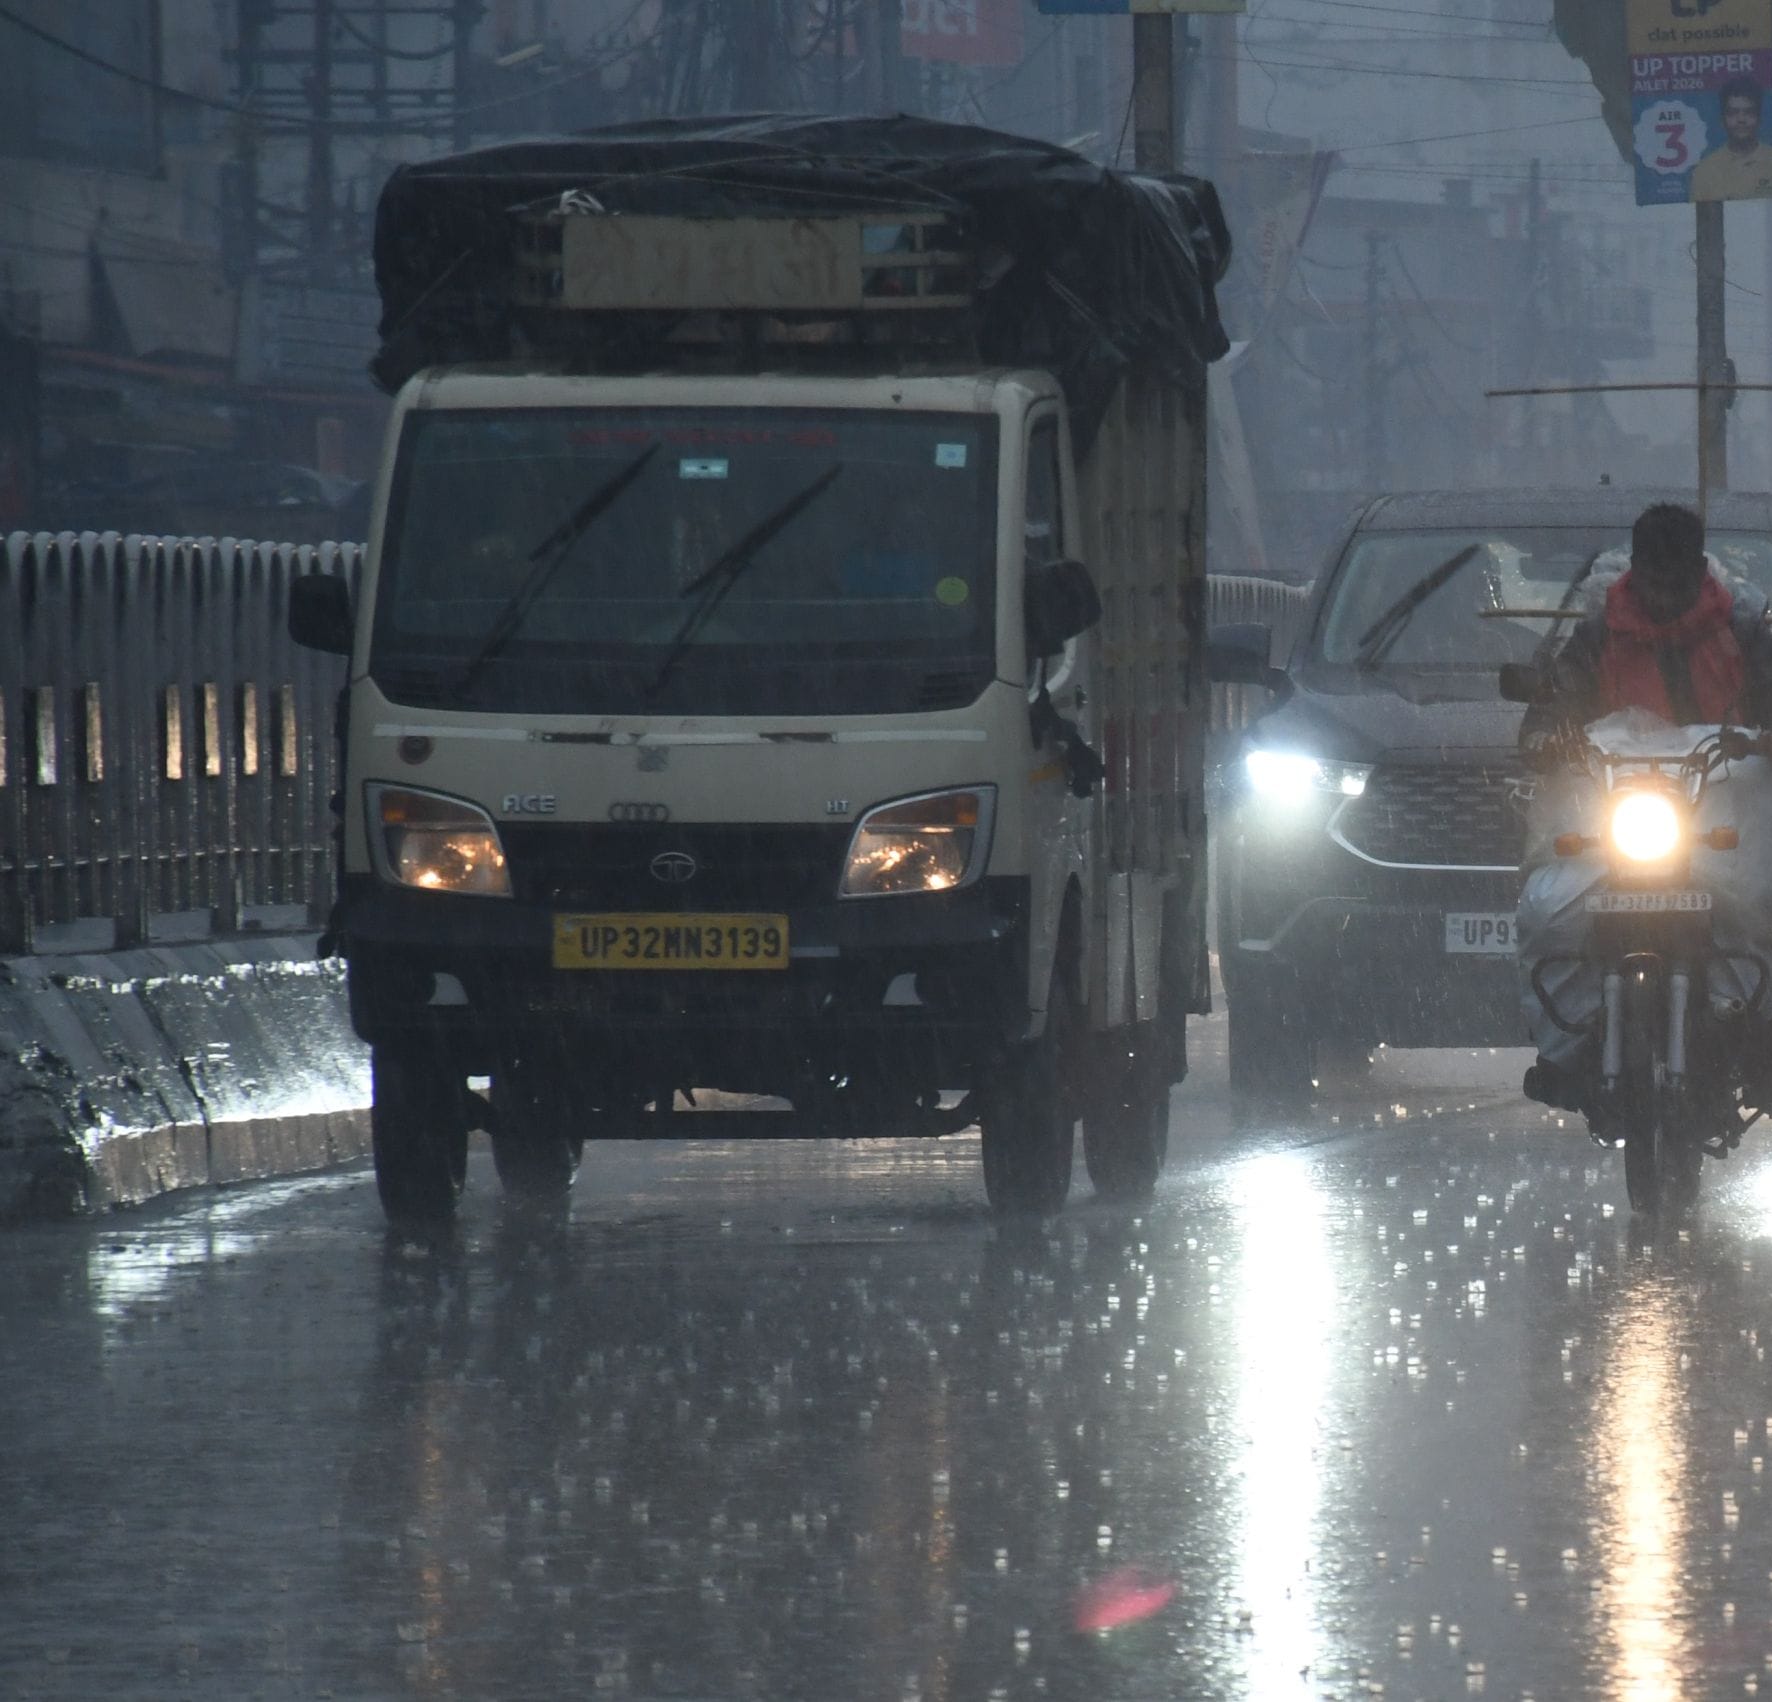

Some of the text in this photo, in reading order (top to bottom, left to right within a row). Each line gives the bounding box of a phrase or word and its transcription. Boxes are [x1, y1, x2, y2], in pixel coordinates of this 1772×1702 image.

[1683, 25, 1750, 43] possible
[1634, 54, 1754, 76] UP TOPPER
[1633, 79, 1705, 92] AILET 2026
[1658, 111, 1682, 121] AIR
[1654, 123, 1688, 168] 3
[502, 793, 558, 814] ACE
[826, 799, 851, 815] HT
[580, 925, 781, 960] UP32MN3139
